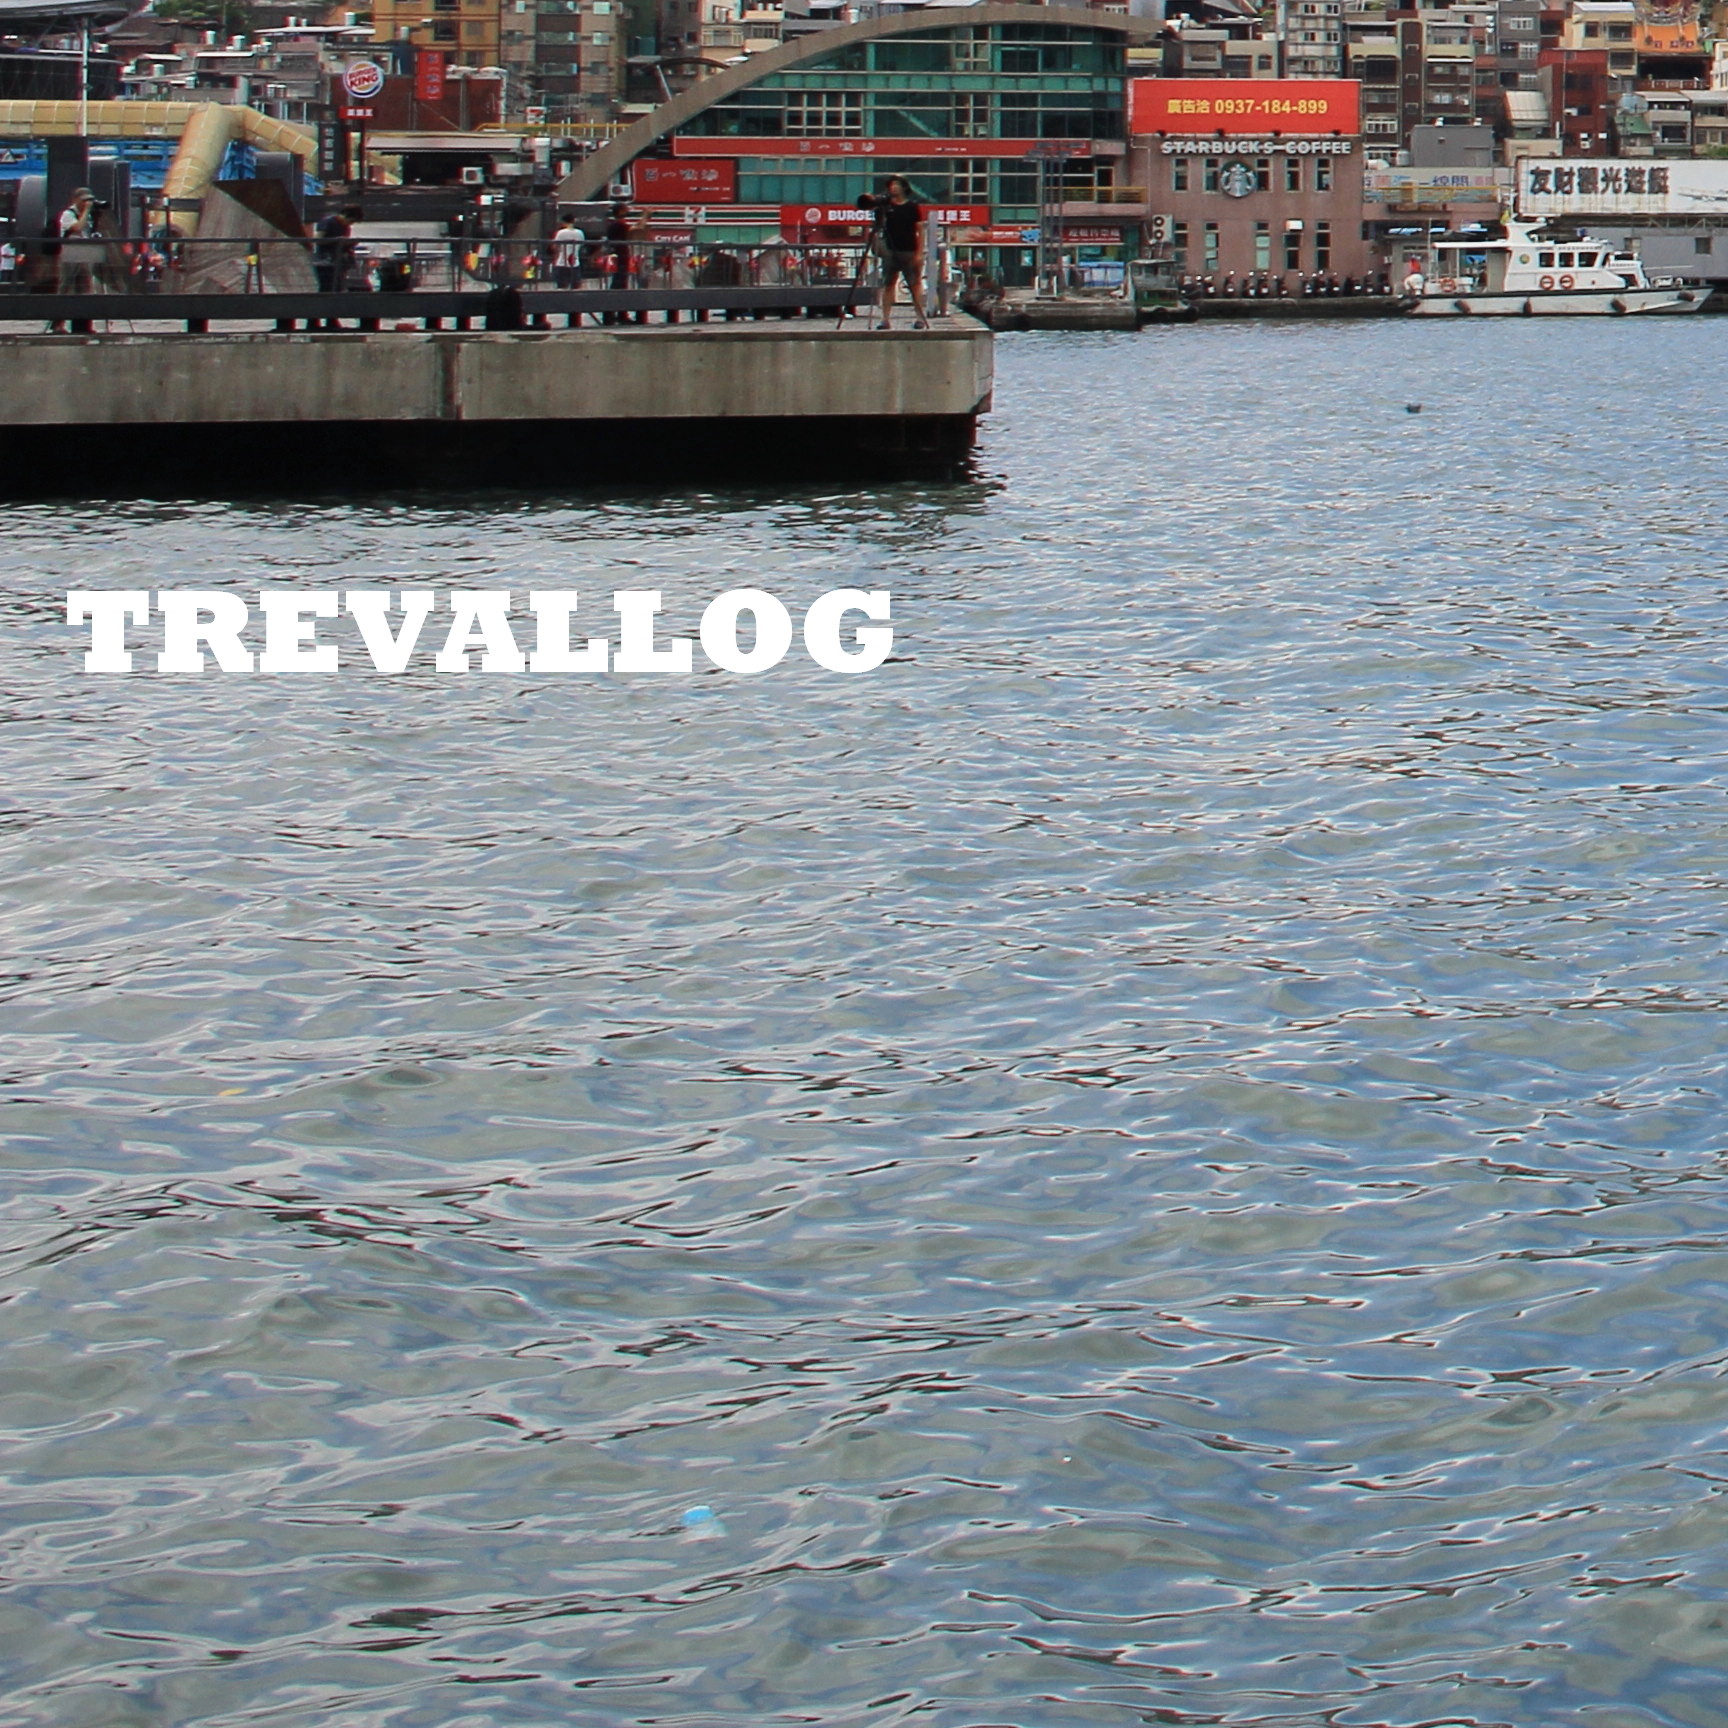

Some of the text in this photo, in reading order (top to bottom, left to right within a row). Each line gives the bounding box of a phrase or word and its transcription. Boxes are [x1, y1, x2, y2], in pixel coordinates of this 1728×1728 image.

[1214, 99, 1328, 114] 0937-184-899
[1161, 140, 1351, 155] STARBUCKS COFFEE
